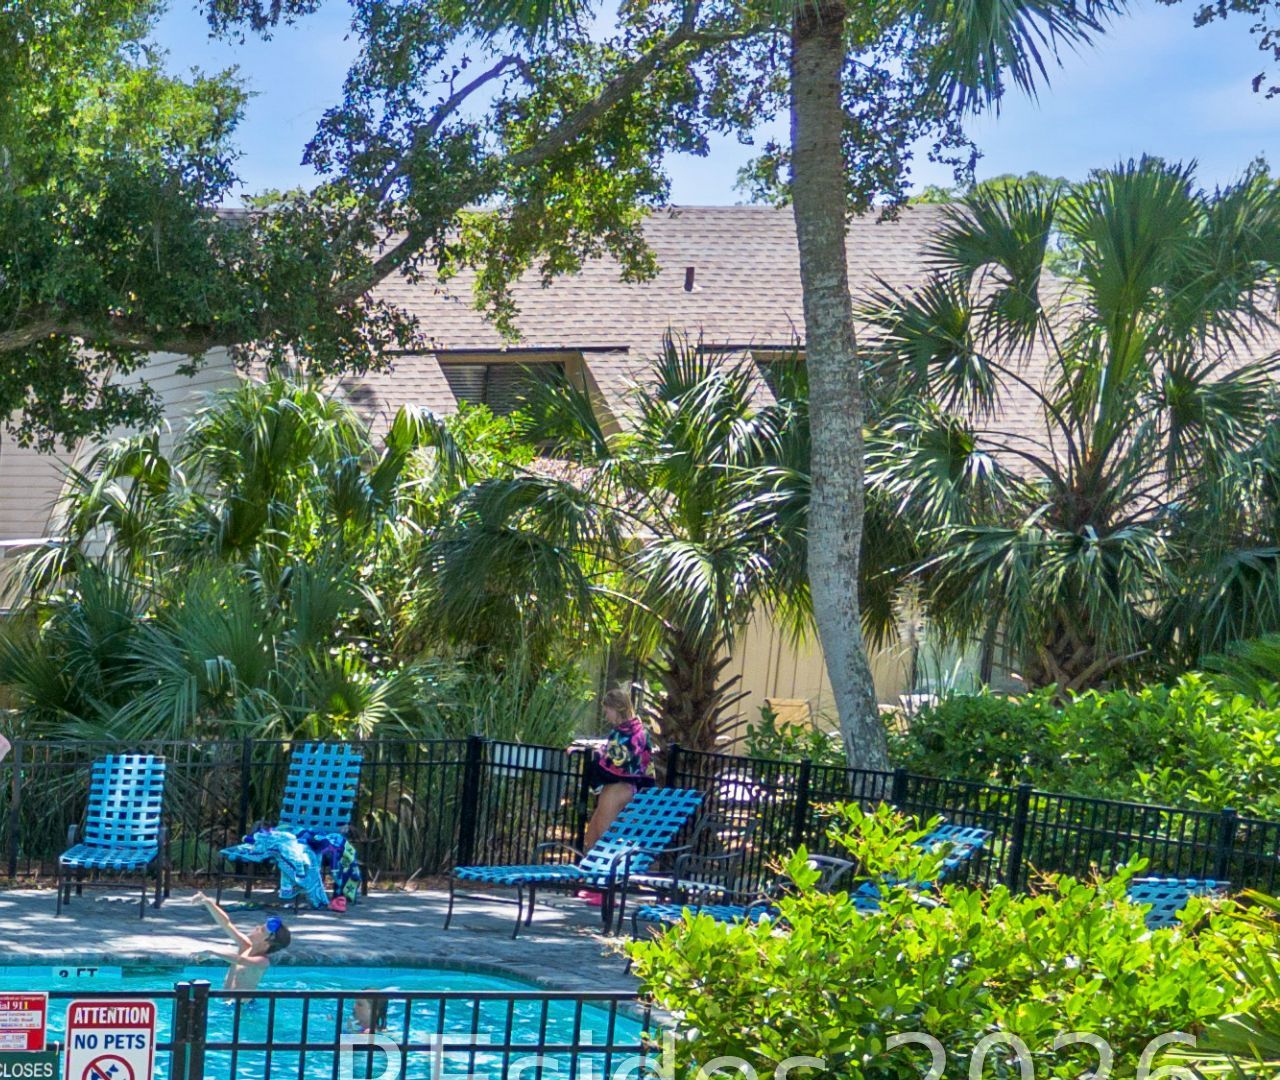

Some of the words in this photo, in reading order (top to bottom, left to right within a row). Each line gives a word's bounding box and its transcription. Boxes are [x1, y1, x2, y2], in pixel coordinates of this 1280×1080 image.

[12, 1000, 29, 1010] 911
[73, 1006, 150, 1024] ATTENTION
[74, 1034, 98, 1050] NO
[103, 1034, 146, 1050] PETS
